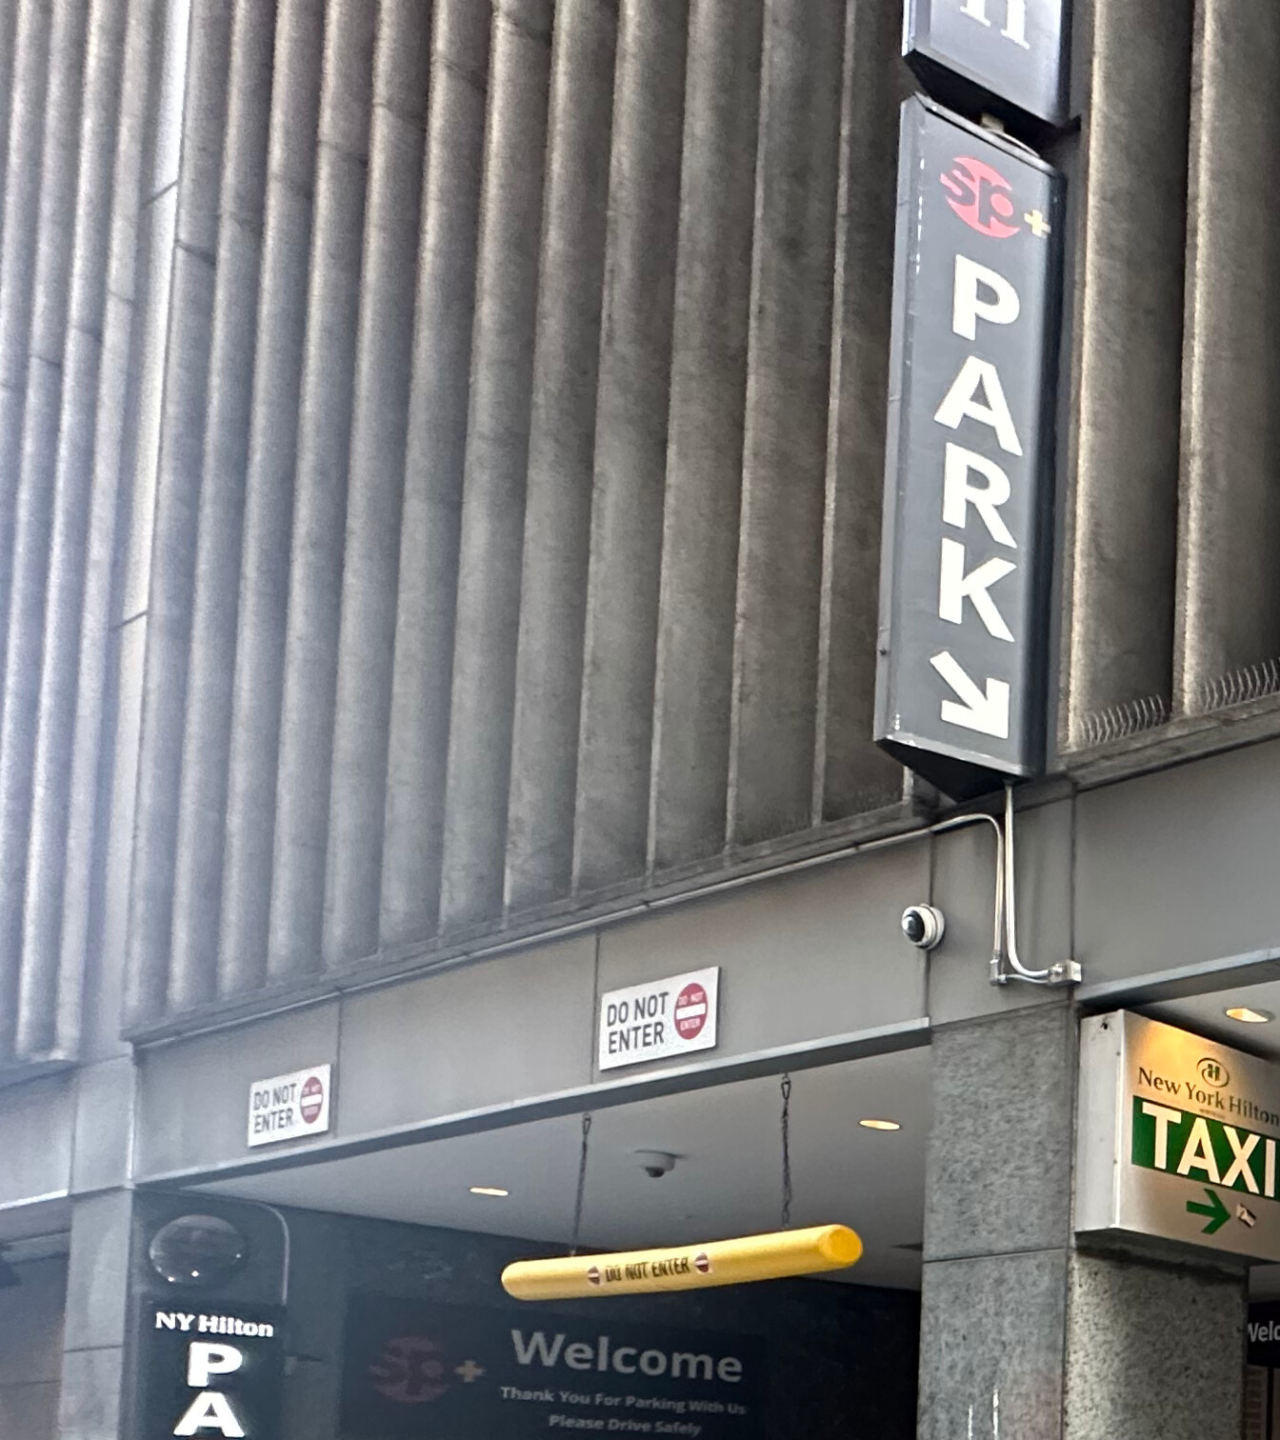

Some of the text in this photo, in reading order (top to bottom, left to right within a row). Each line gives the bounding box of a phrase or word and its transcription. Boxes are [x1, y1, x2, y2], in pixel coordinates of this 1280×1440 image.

[933, 253, 1023, 643] PARK
[607, 991, 669, 1027] DO NOT
[608, 1021, 664, 1054] ENTER
[253, 1089, 270, 1111] DO
[272, 1083, 297, 1106] NOT
[1137, 1066, 1280, 1127] New York Hilton
[254, 1107, 294, 1133] ENTER
[1141, 1101, 1276, 1198] TAXI
[604, 1257, 690, 1282] DO NOT ENTER
[154, 1311, 275, 1338] NY Hilton
[511, 1328, 743, 1383] Welcome
[500, 1385, 747, 1416] Thank You For Parking With Us
[549, 1413, 702, 1438] Please Drive Safely
